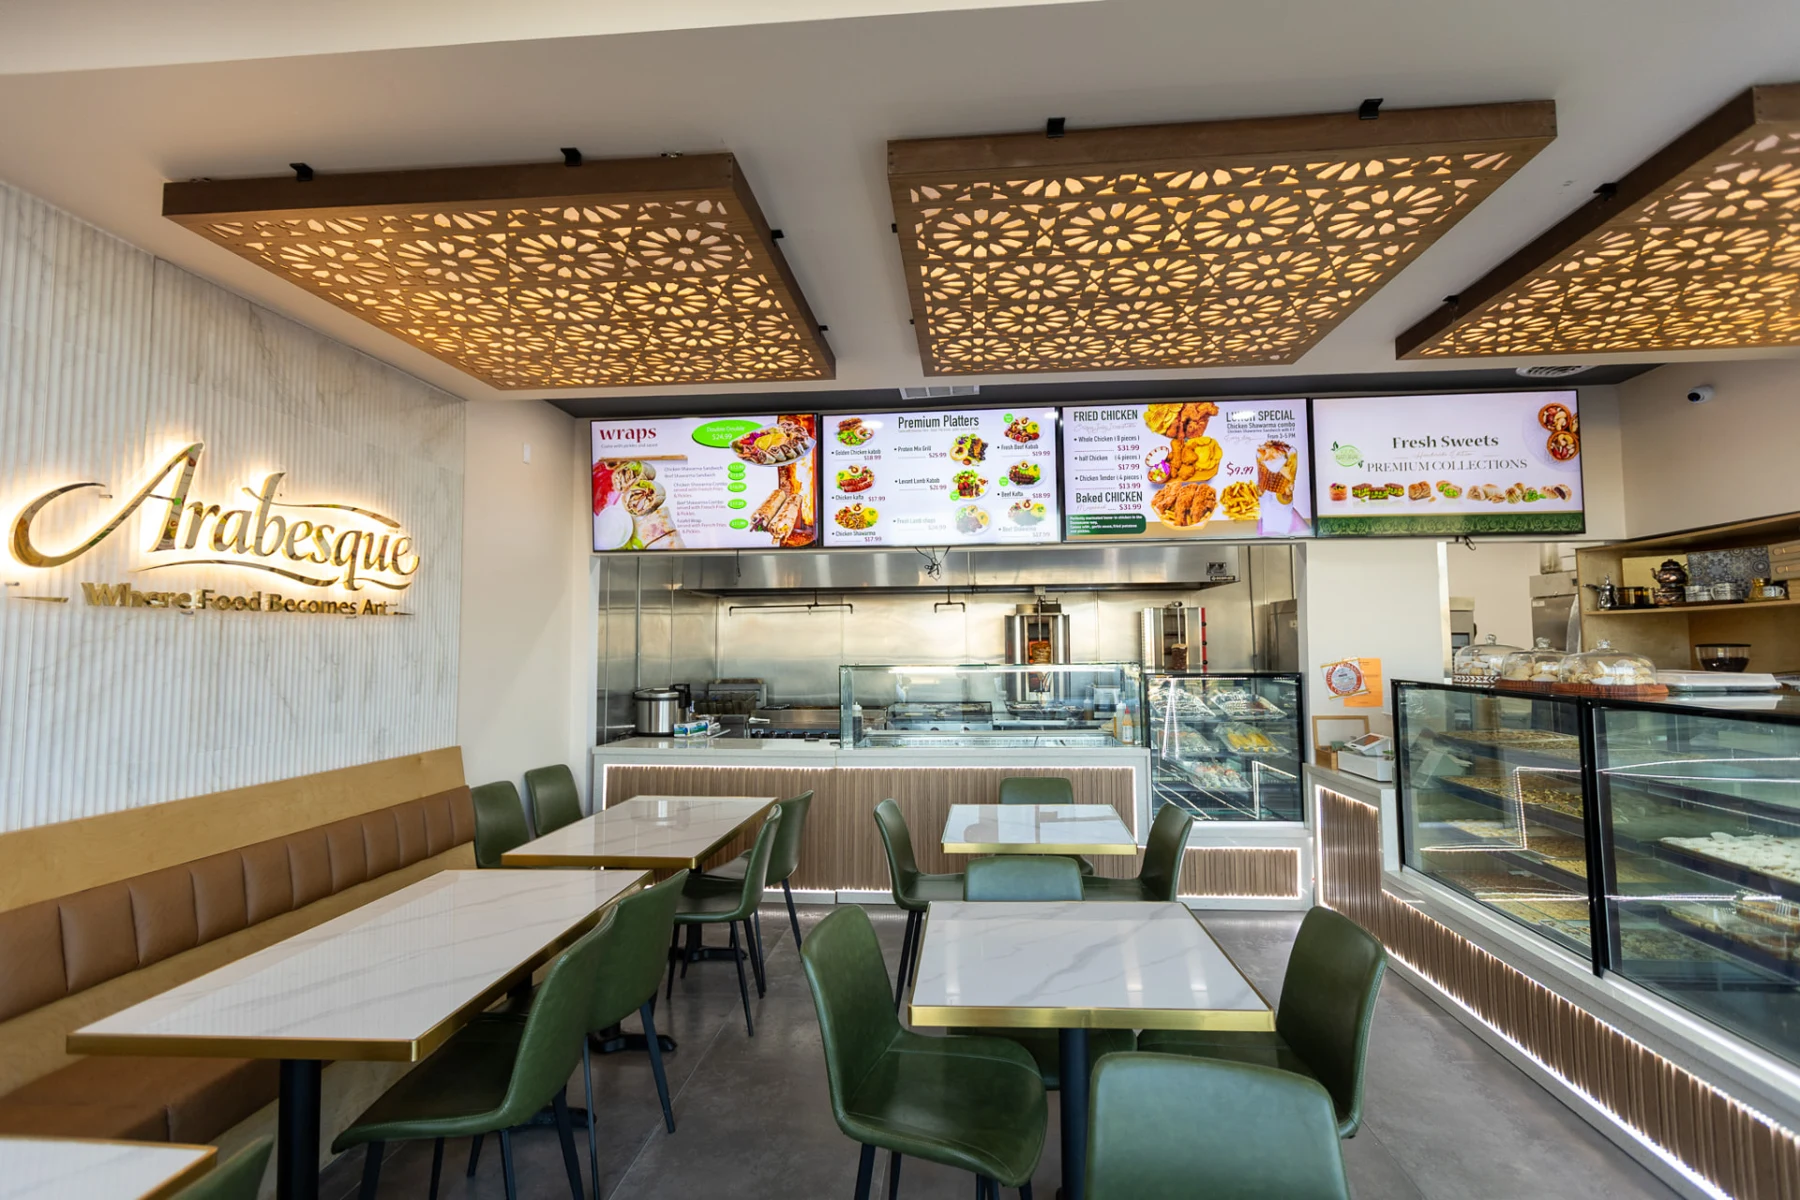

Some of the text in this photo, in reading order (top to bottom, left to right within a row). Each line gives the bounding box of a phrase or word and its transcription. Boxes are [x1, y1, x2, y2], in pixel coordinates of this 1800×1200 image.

[898, 415, 979, 429] Premium Platters
[1074, 410, 1138, 421] FRIED CHICKEN
[1258, 410, 1295, 421] SPECIAL
[600, 427, 657, 443] wraps
[1392, 435, 1499, 449] Fresh Sweets
[1226, 462, 1254, 476] $9.99
[1367, 459, 1528, 472] PREMIUM COLLECTIONS
[1076, 491, 1143, 503] Baked CHICKEN
[9, 442, 420, 591] Arabesque
[82, 582, 389, 616] Where Food Becomes Art
